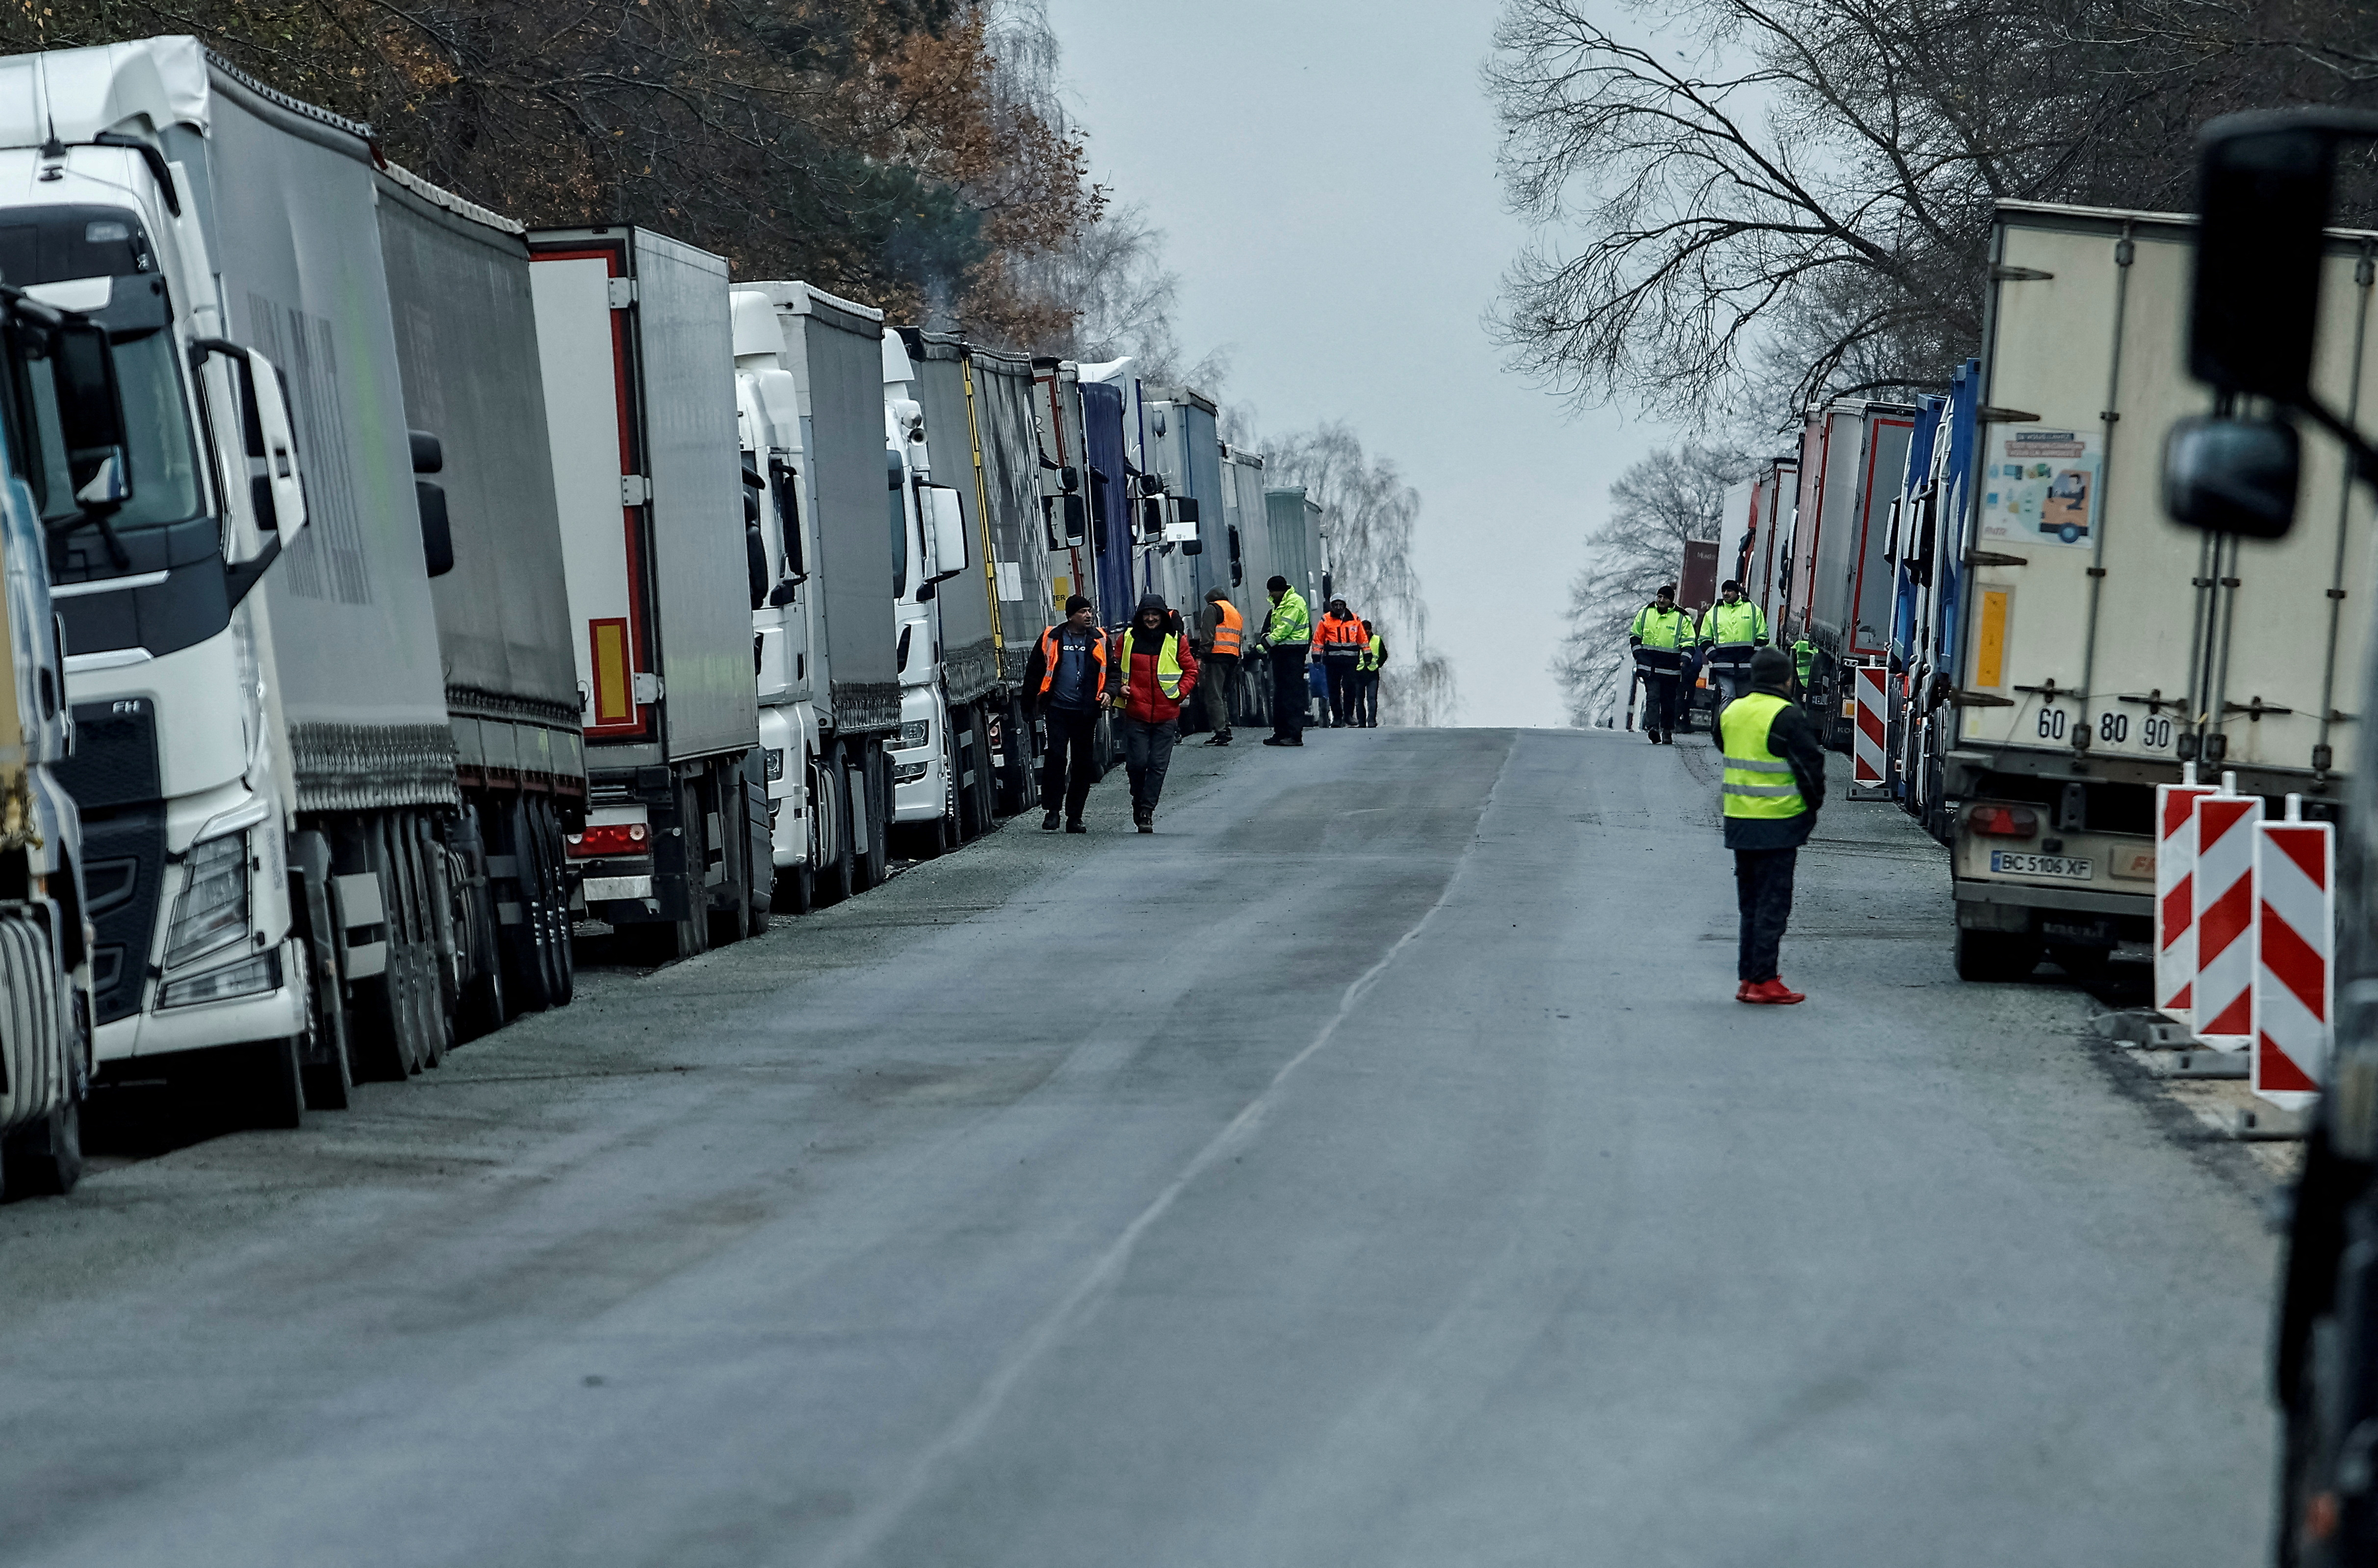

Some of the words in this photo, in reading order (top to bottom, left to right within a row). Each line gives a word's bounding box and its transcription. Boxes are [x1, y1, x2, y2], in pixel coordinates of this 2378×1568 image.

[112, 700, 140, 713] FH
[2039, 708, 2064, 739] 60
[2101, 713, 2127, 742] 80
[2144, 719, 2169, 747] 90
[2003, 854, 2023, 870] BC
[2027, 857, 2062, 873] 5106
[2066, 859, 2088, 874] XF
